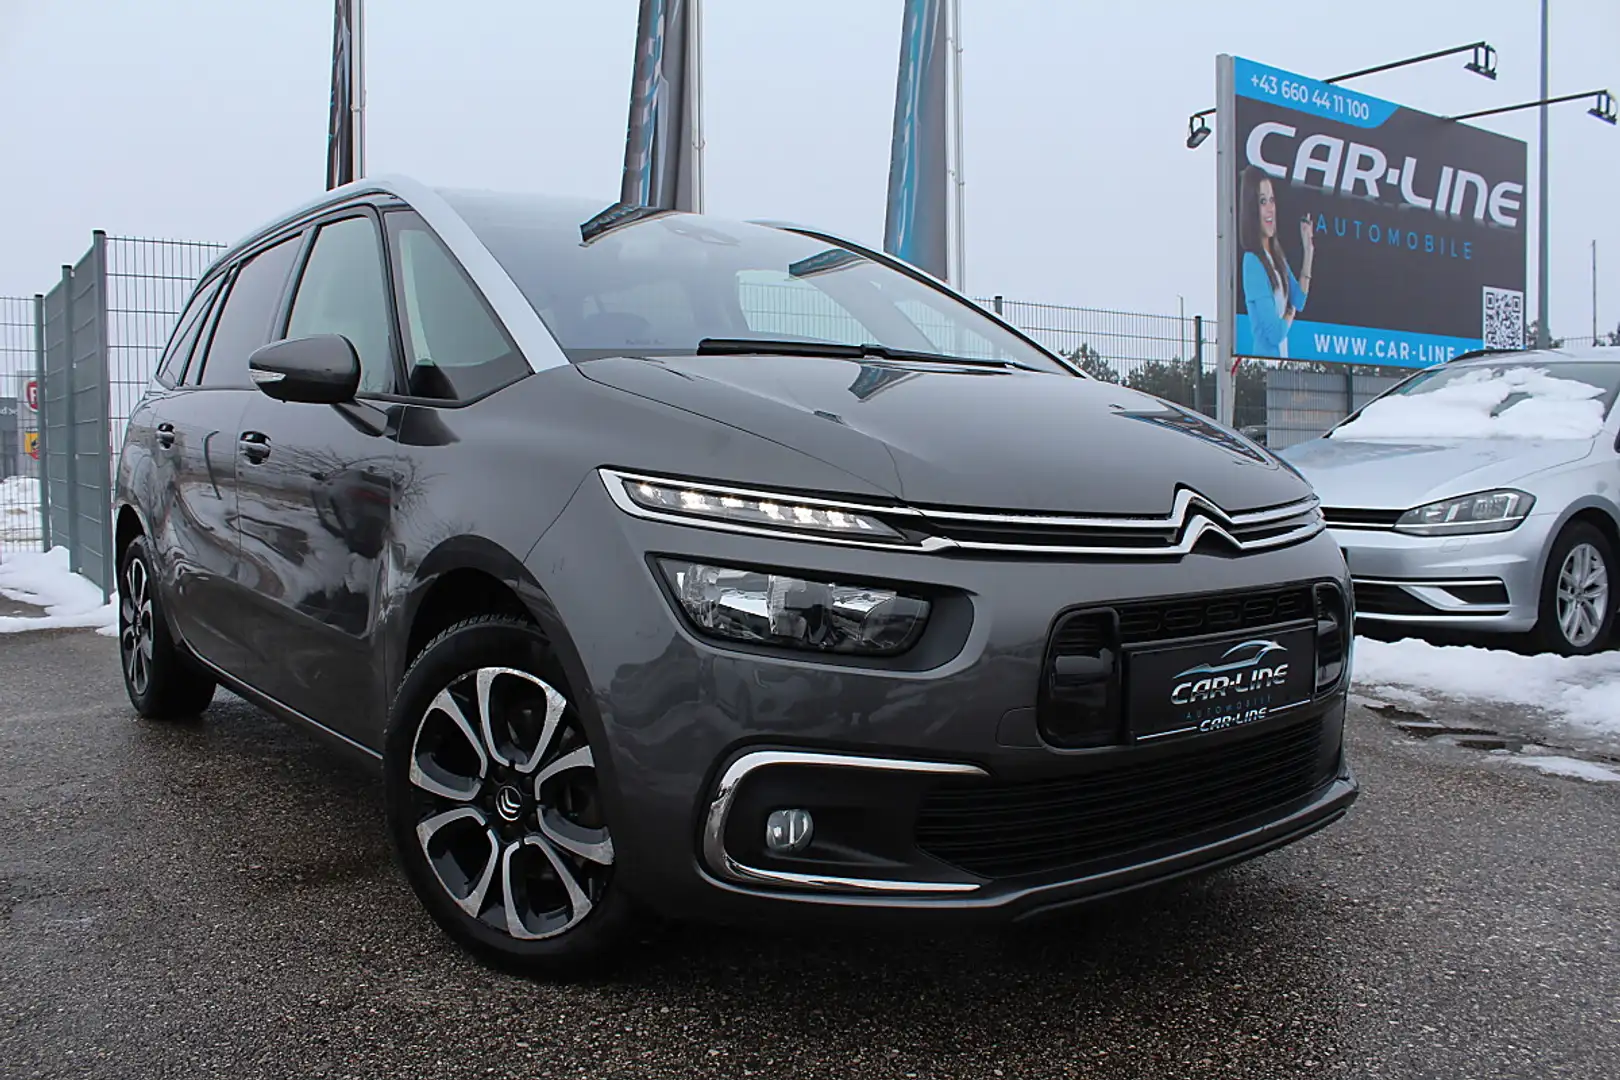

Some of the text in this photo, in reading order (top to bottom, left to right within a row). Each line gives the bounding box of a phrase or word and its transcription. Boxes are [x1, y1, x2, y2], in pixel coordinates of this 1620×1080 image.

[1251, 74, 1278, 95] +43
[1281, 80, 1309, 103] 660
[1312, 89, 1331, 110] 44
[1346, 98, 1369, 120] 100
[1316, 213, 1473, 260] AUTOMOBILE
[1314, 333, 1477, 363] WWW.CAR-LINE
